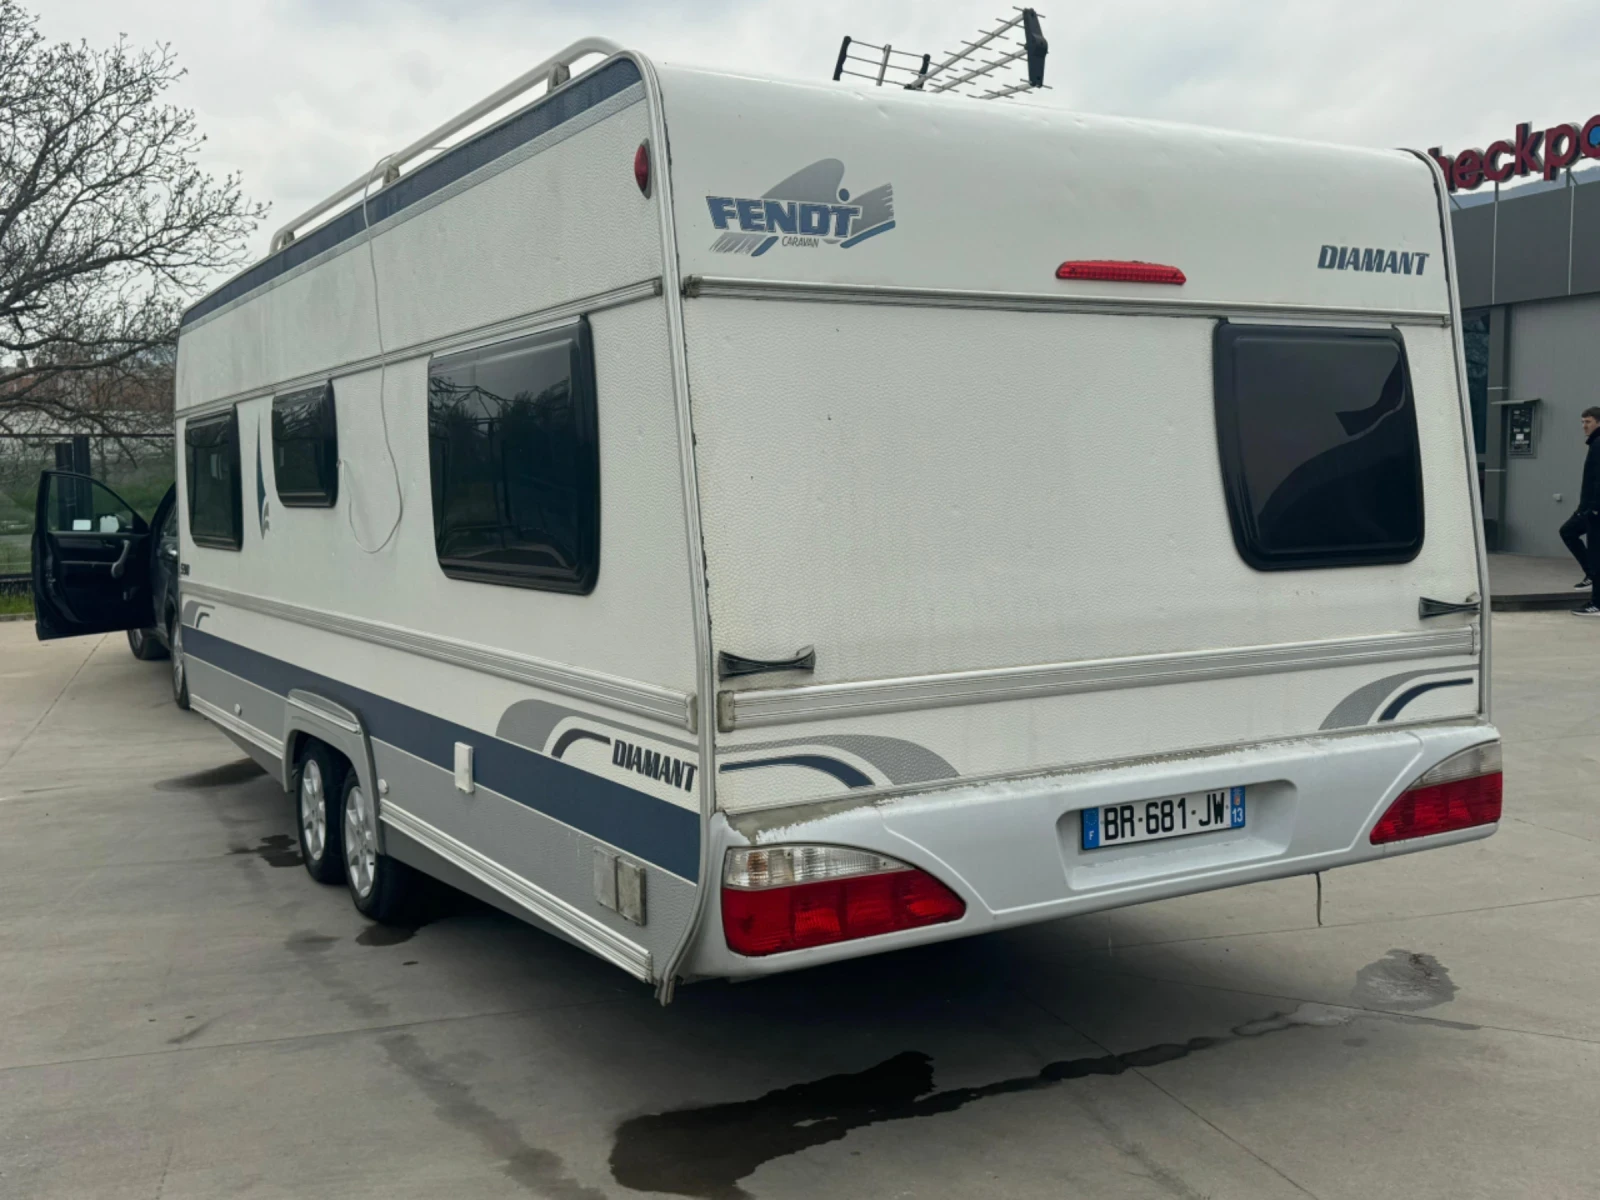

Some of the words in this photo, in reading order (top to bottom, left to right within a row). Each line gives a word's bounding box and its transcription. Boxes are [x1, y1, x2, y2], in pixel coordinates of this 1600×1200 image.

[705, 195, 861, 239] FENDT
[781, 235, 820, 248] CARAVAN
[1317, 244, 1430, 276] DIAMANT
[612, 738, 698, 793] DIAMANT
[1088, 830, 1095, 841] F
[1231, 807, 1244, 823] 13
